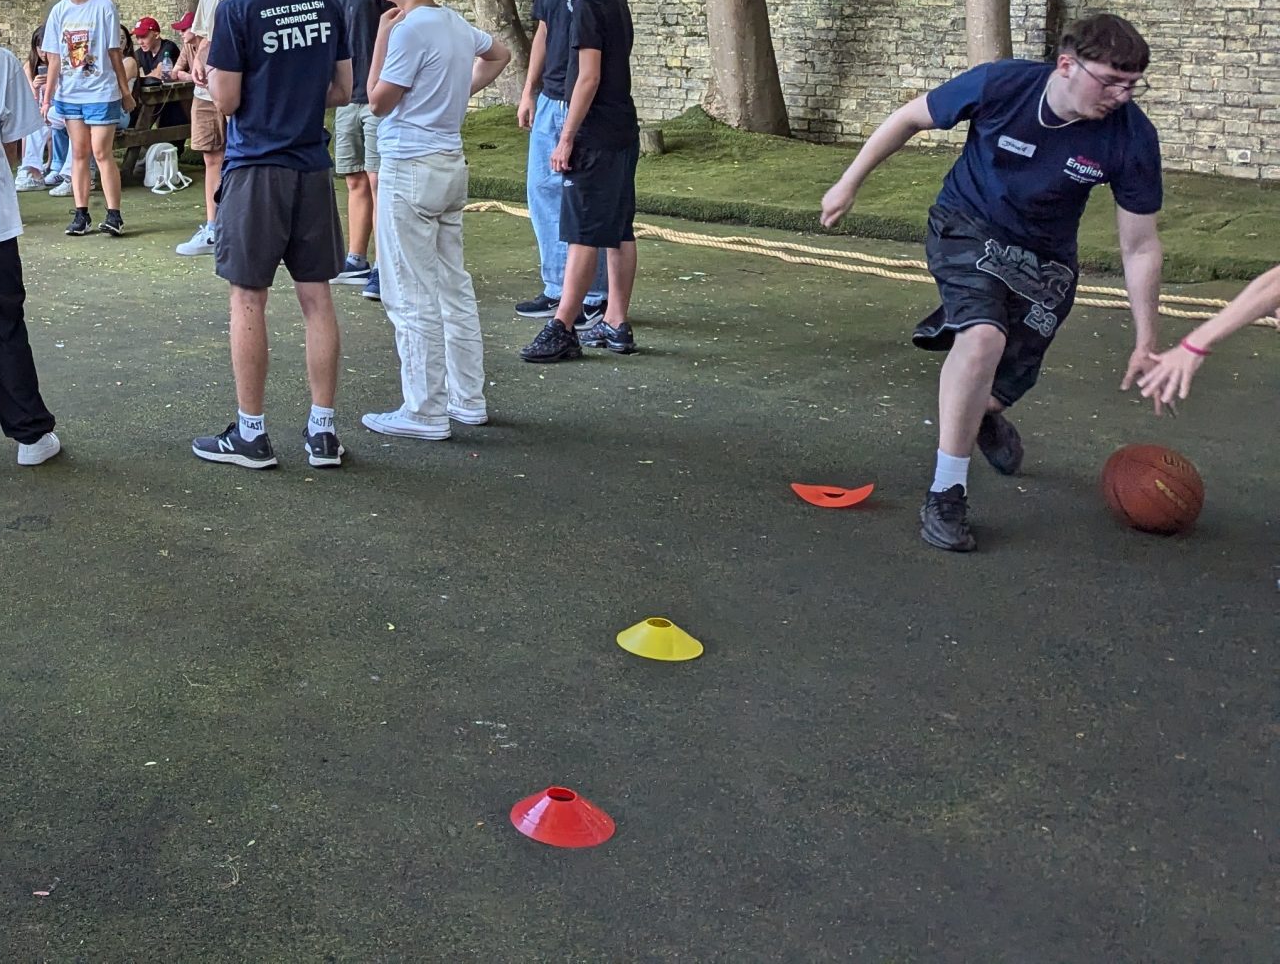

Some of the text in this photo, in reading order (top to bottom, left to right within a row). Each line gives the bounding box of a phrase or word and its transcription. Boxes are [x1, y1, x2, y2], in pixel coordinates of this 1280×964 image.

[260, 0, 325, 19] SELECT ENGLISH
[263, 22, 331, 54] STAFF
[1066, 157, 1104, 178] English
[1024, 304, 1058, 338] 23
